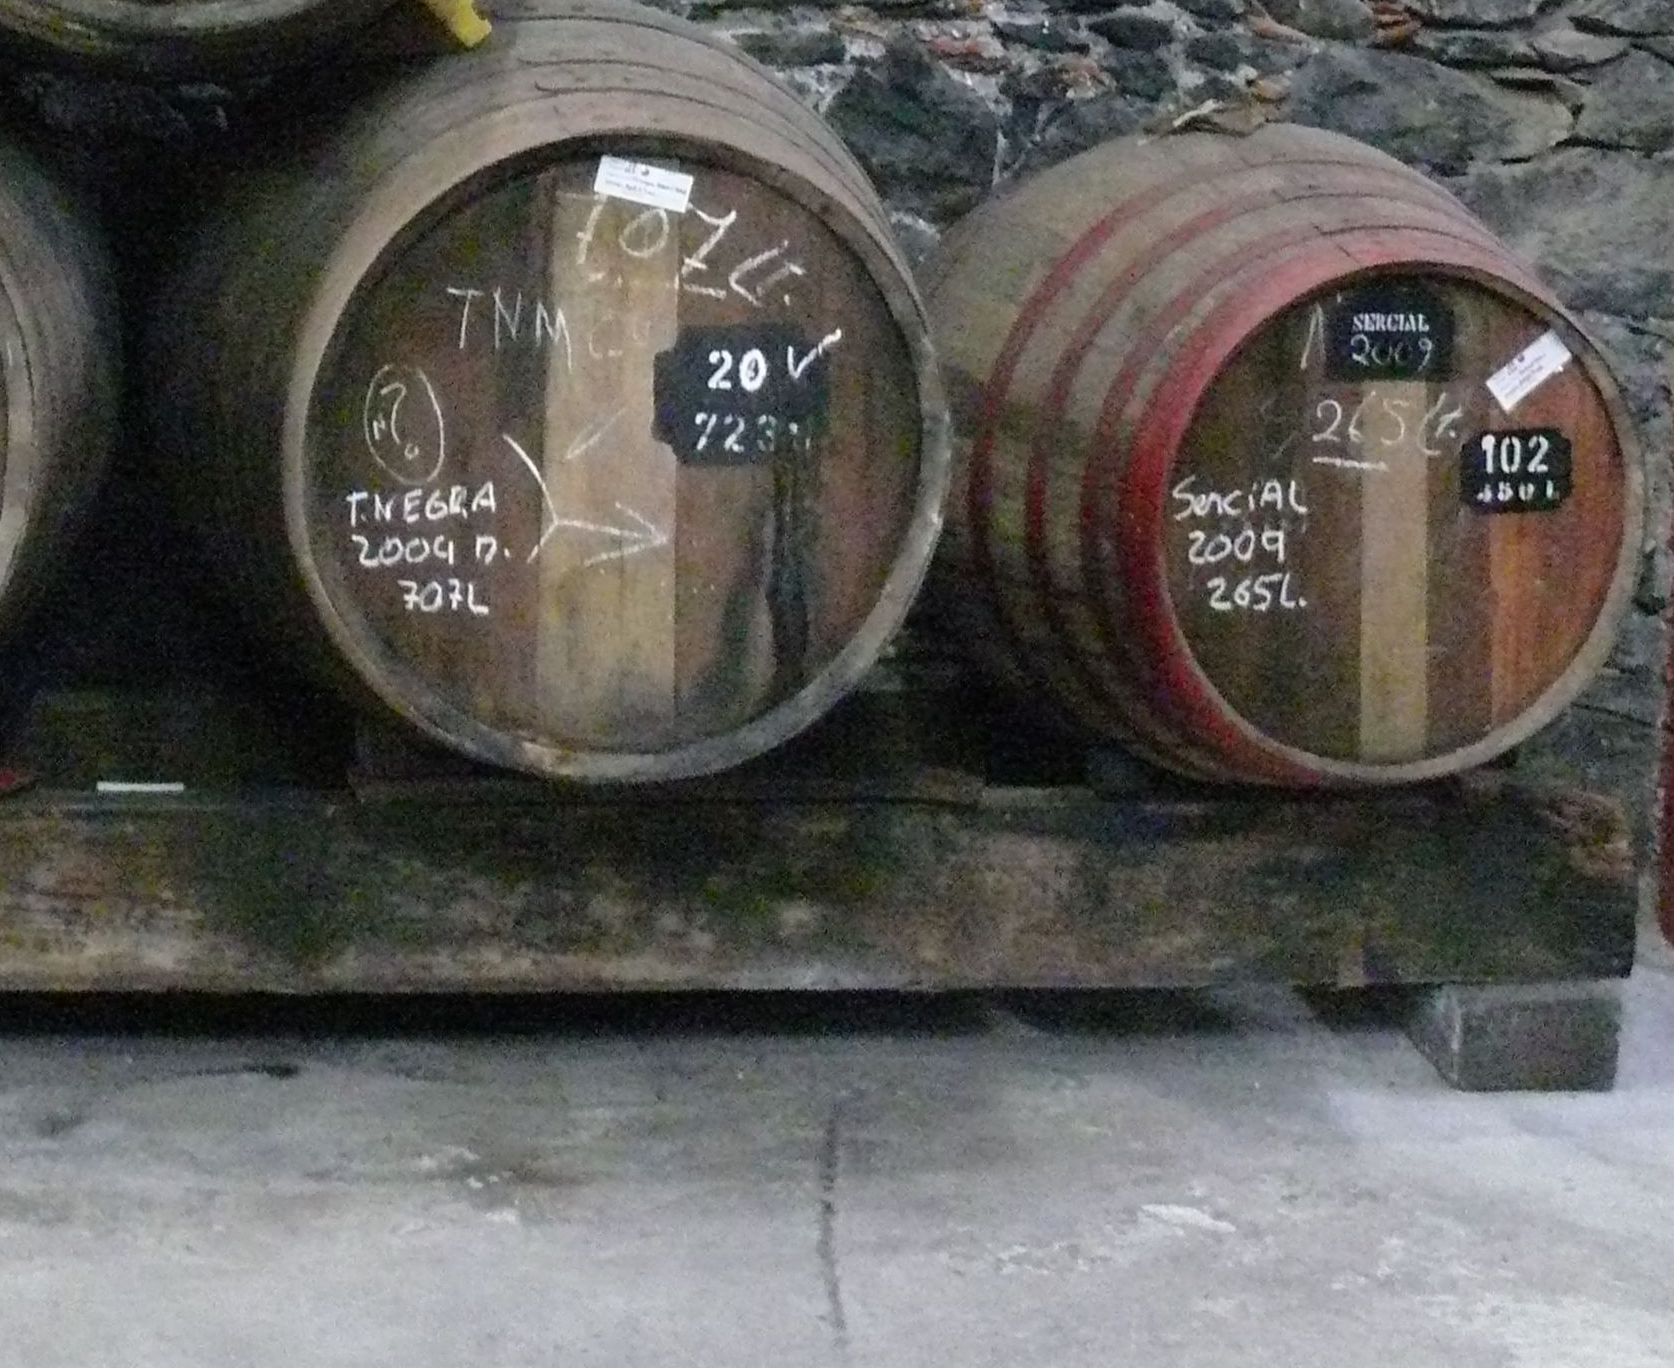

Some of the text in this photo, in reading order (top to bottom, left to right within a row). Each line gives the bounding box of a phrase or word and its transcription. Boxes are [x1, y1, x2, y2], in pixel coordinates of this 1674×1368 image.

[1352, 312, 1430, 332] SERCIAL
[707, 348, 767, 392] 20
[1480, 433, 1550, 474] 102
[346, 481, 498, 528] T.NEGRA
[351, 533, 456, 568] 2004
[1188, 529, 1287, 565] 2009
[397, 578, 491, 616] 707L
